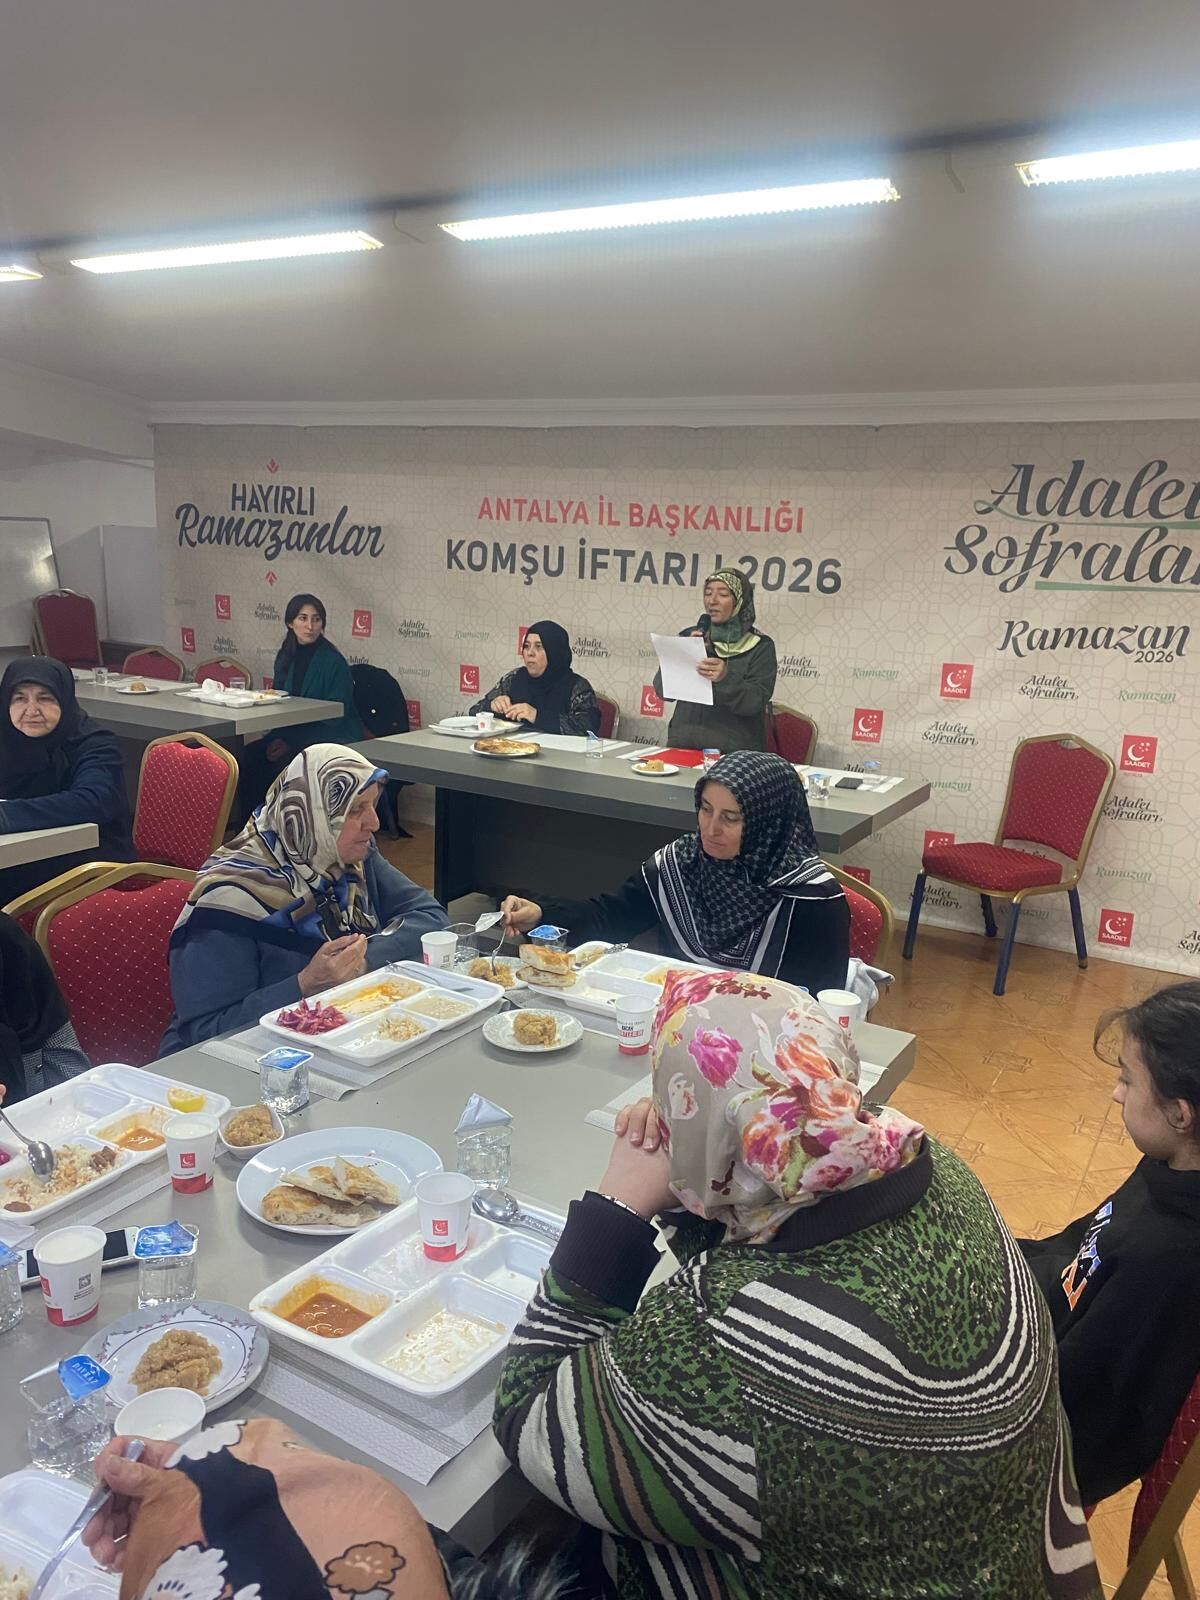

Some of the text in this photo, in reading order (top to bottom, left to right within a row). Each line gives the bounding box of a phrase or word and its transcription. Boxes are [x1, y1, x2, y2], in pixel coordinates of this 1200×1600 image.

[230, 482, 315, 516] HAYIRLI
[477, 494, 804, 537] ANTALYA İL BAŞKANLIĞI
[175, 503, 385, 561] Ramazanlar
[447, 537, 842, 594] KOMŞU İFTARI 2026
[997, 619, 1190, 657] Ramazan
[778, 655, 812, 667] Adalet
[1133, 650, 1174, 664] 2026
[1025, 675, 1068, 688] Adalet
[943, 686, 967, 695] SAADET
[1019, 685, 1079, 700] Sofraları
[1118, 689, 1177, 704] Ramazan
[929, 721, 969, 734] Adalet
[922, 731, 979, 745] Sofraları
[1124, 759, 1151, 768] SAADET
[1106, 795, 1151, 811] Adalet
[1096, 865, 1152, 882] Ramazan
[923, 884, 952, 897] dalet
[1102, 932, 1128, 942] SAADET
